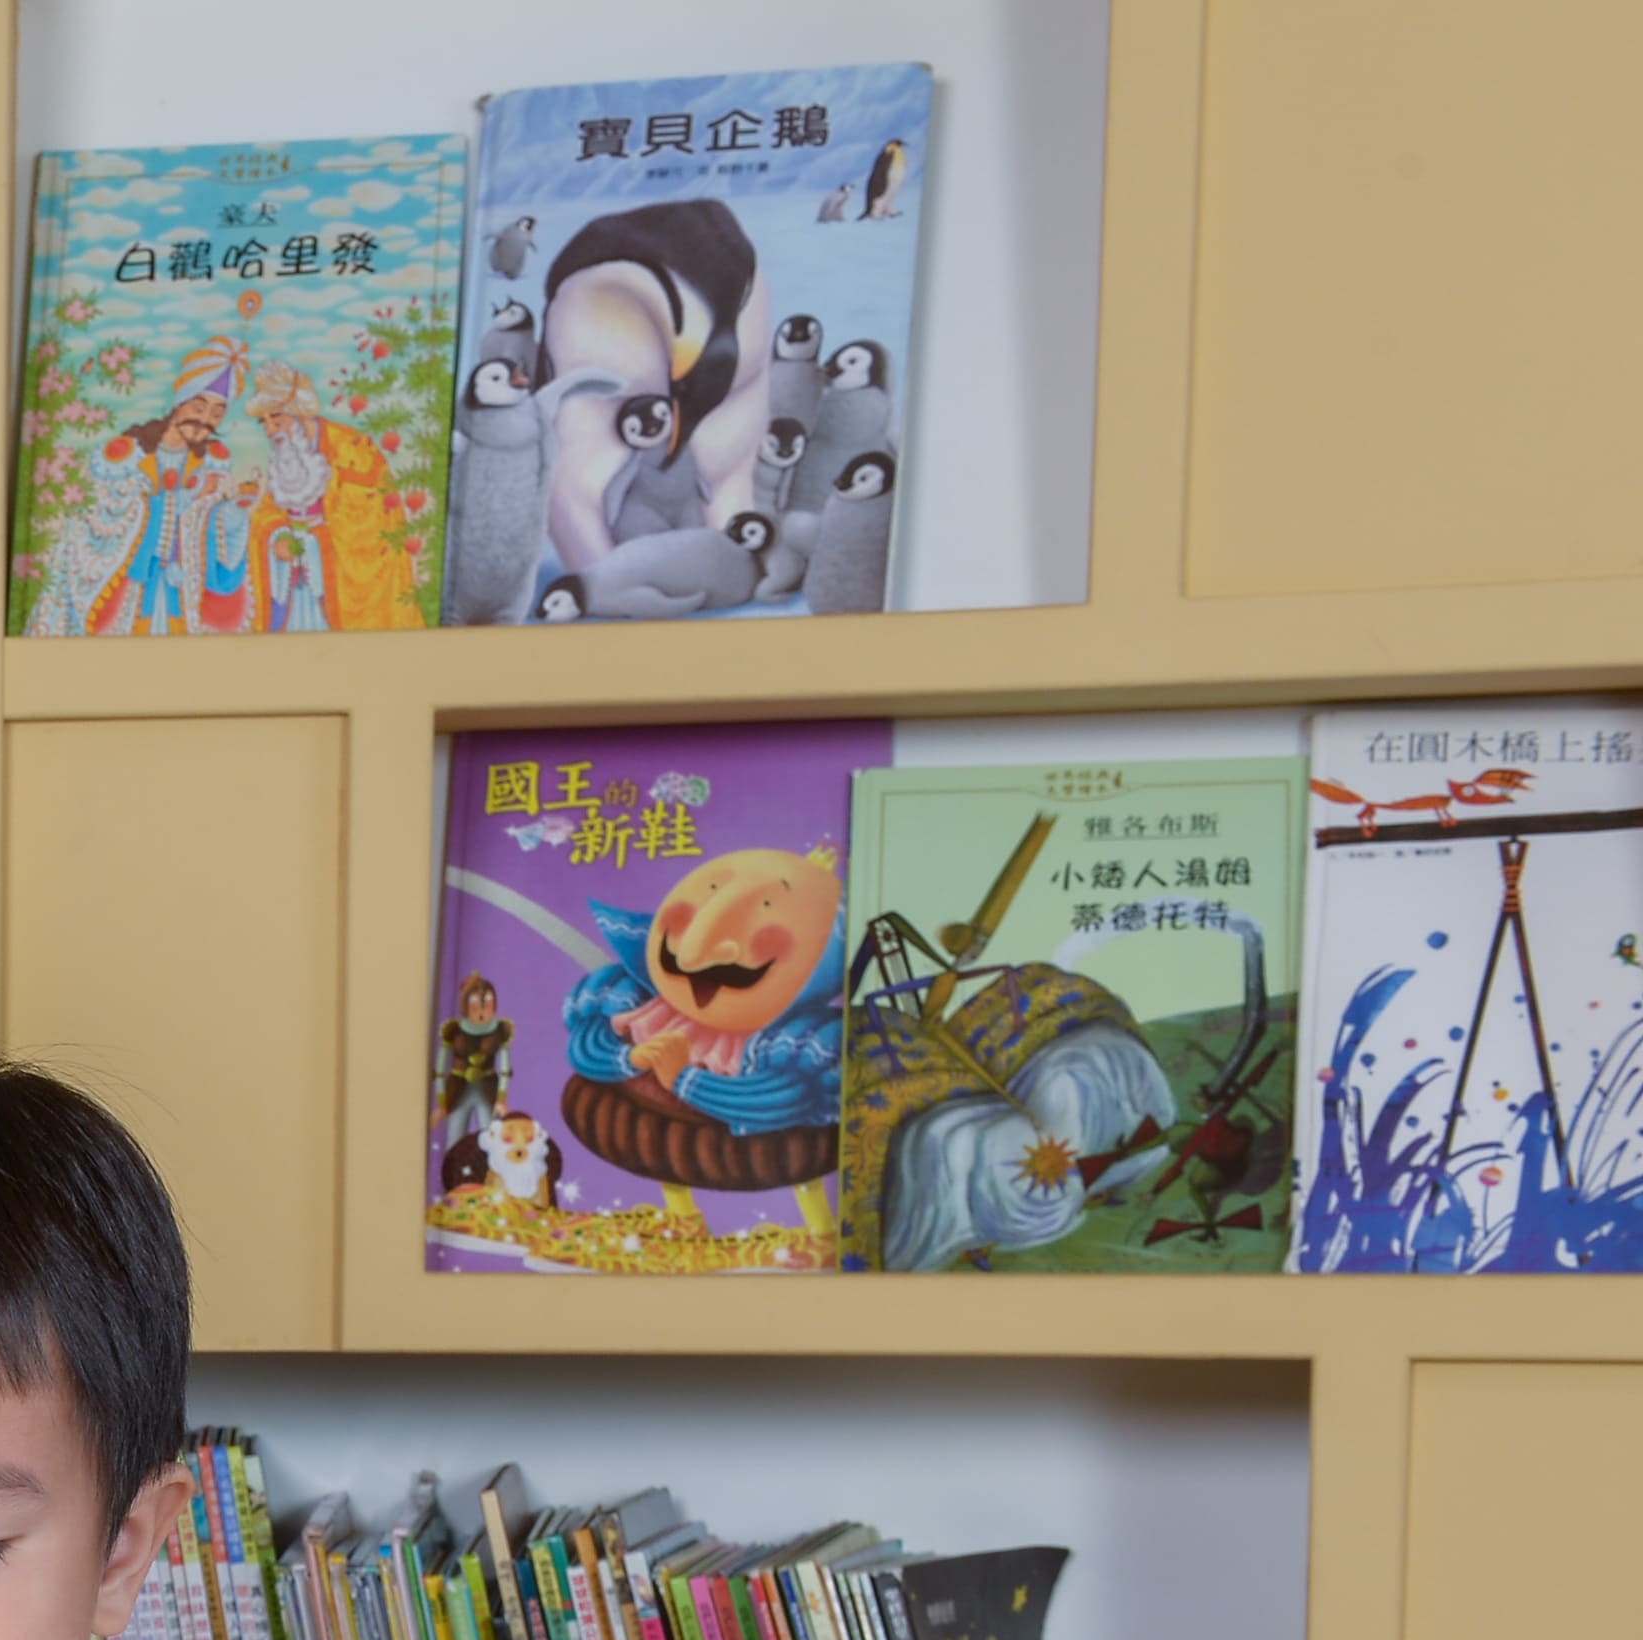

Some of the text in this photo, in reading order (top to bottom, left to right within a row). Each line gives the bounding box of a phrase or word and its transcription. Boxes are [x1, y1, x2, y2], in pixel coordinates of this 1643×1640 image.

[575, 103, 830, 161] 寶貝企鵝
[1365, 729, 1643, 764] 在圓木橋上搖
[570, 798, 703, 869] 新鞋
